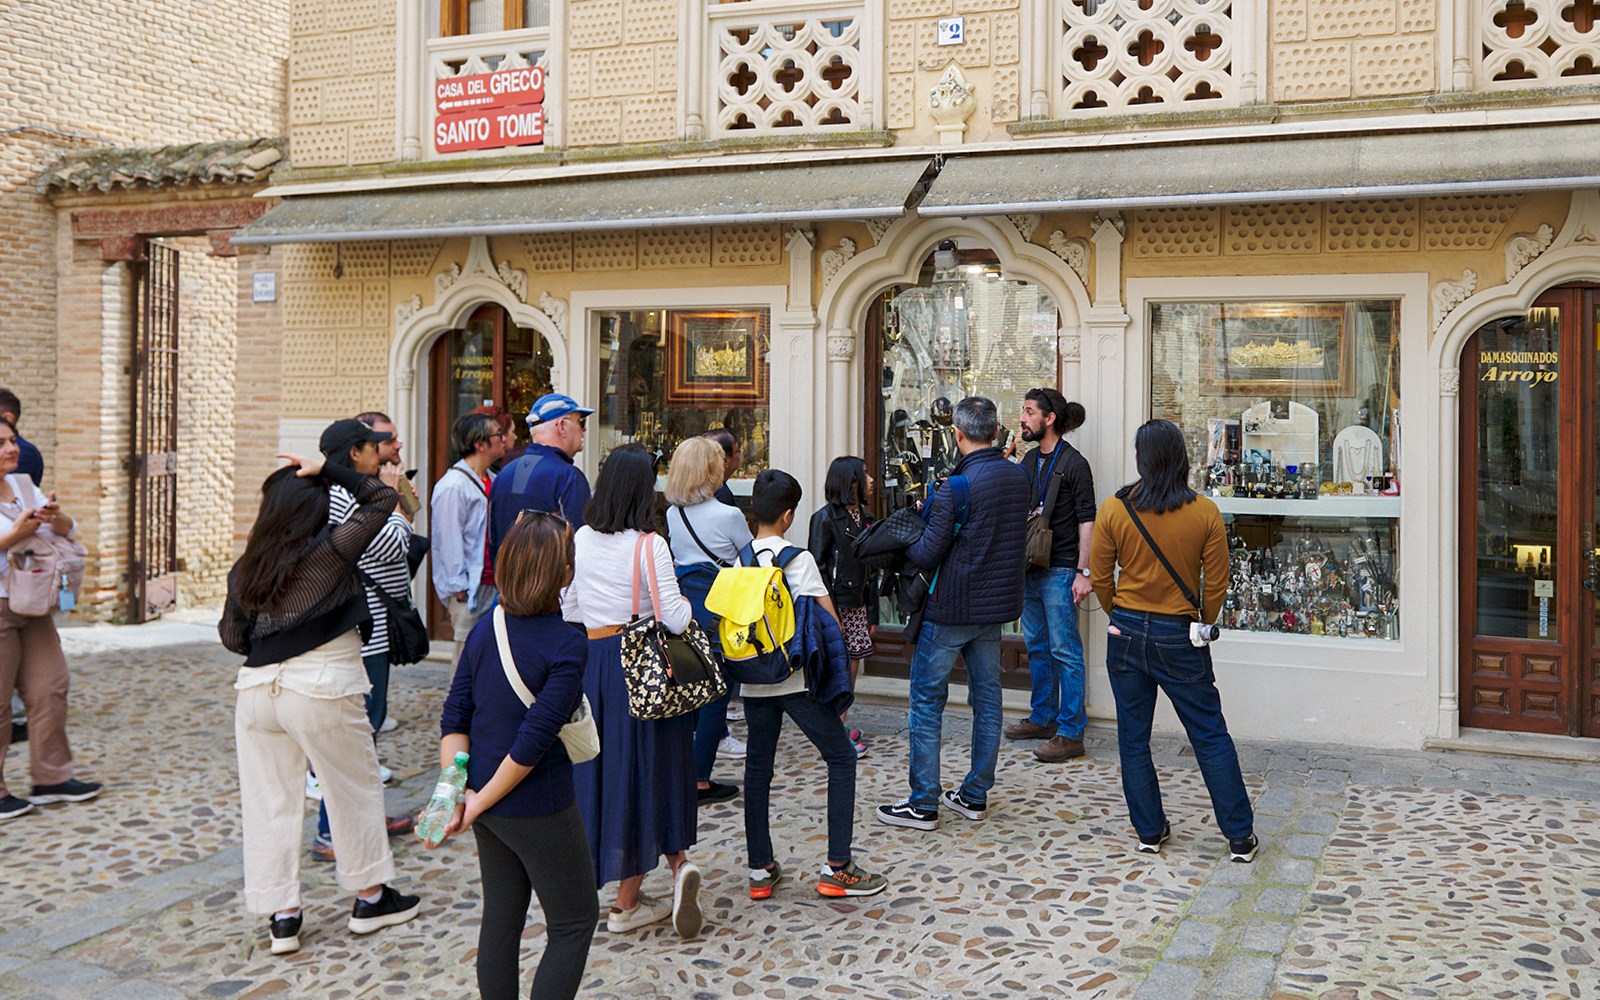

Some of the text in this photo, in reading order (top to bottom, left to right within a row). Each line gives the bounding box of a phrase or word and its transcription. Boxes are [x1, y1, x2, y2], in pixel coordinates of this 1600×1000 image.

[949, 23, 960, 39] 2
[437, 69, 542, 98] CASA DEL GRECO
[436, 117, 490, 146] SANTO
[1480, 352, 1558, 364] DAMASQUINADOS
[452, 368, 493, 383] Arroyo
[1481, 366, 1558, 388] Arroyo
